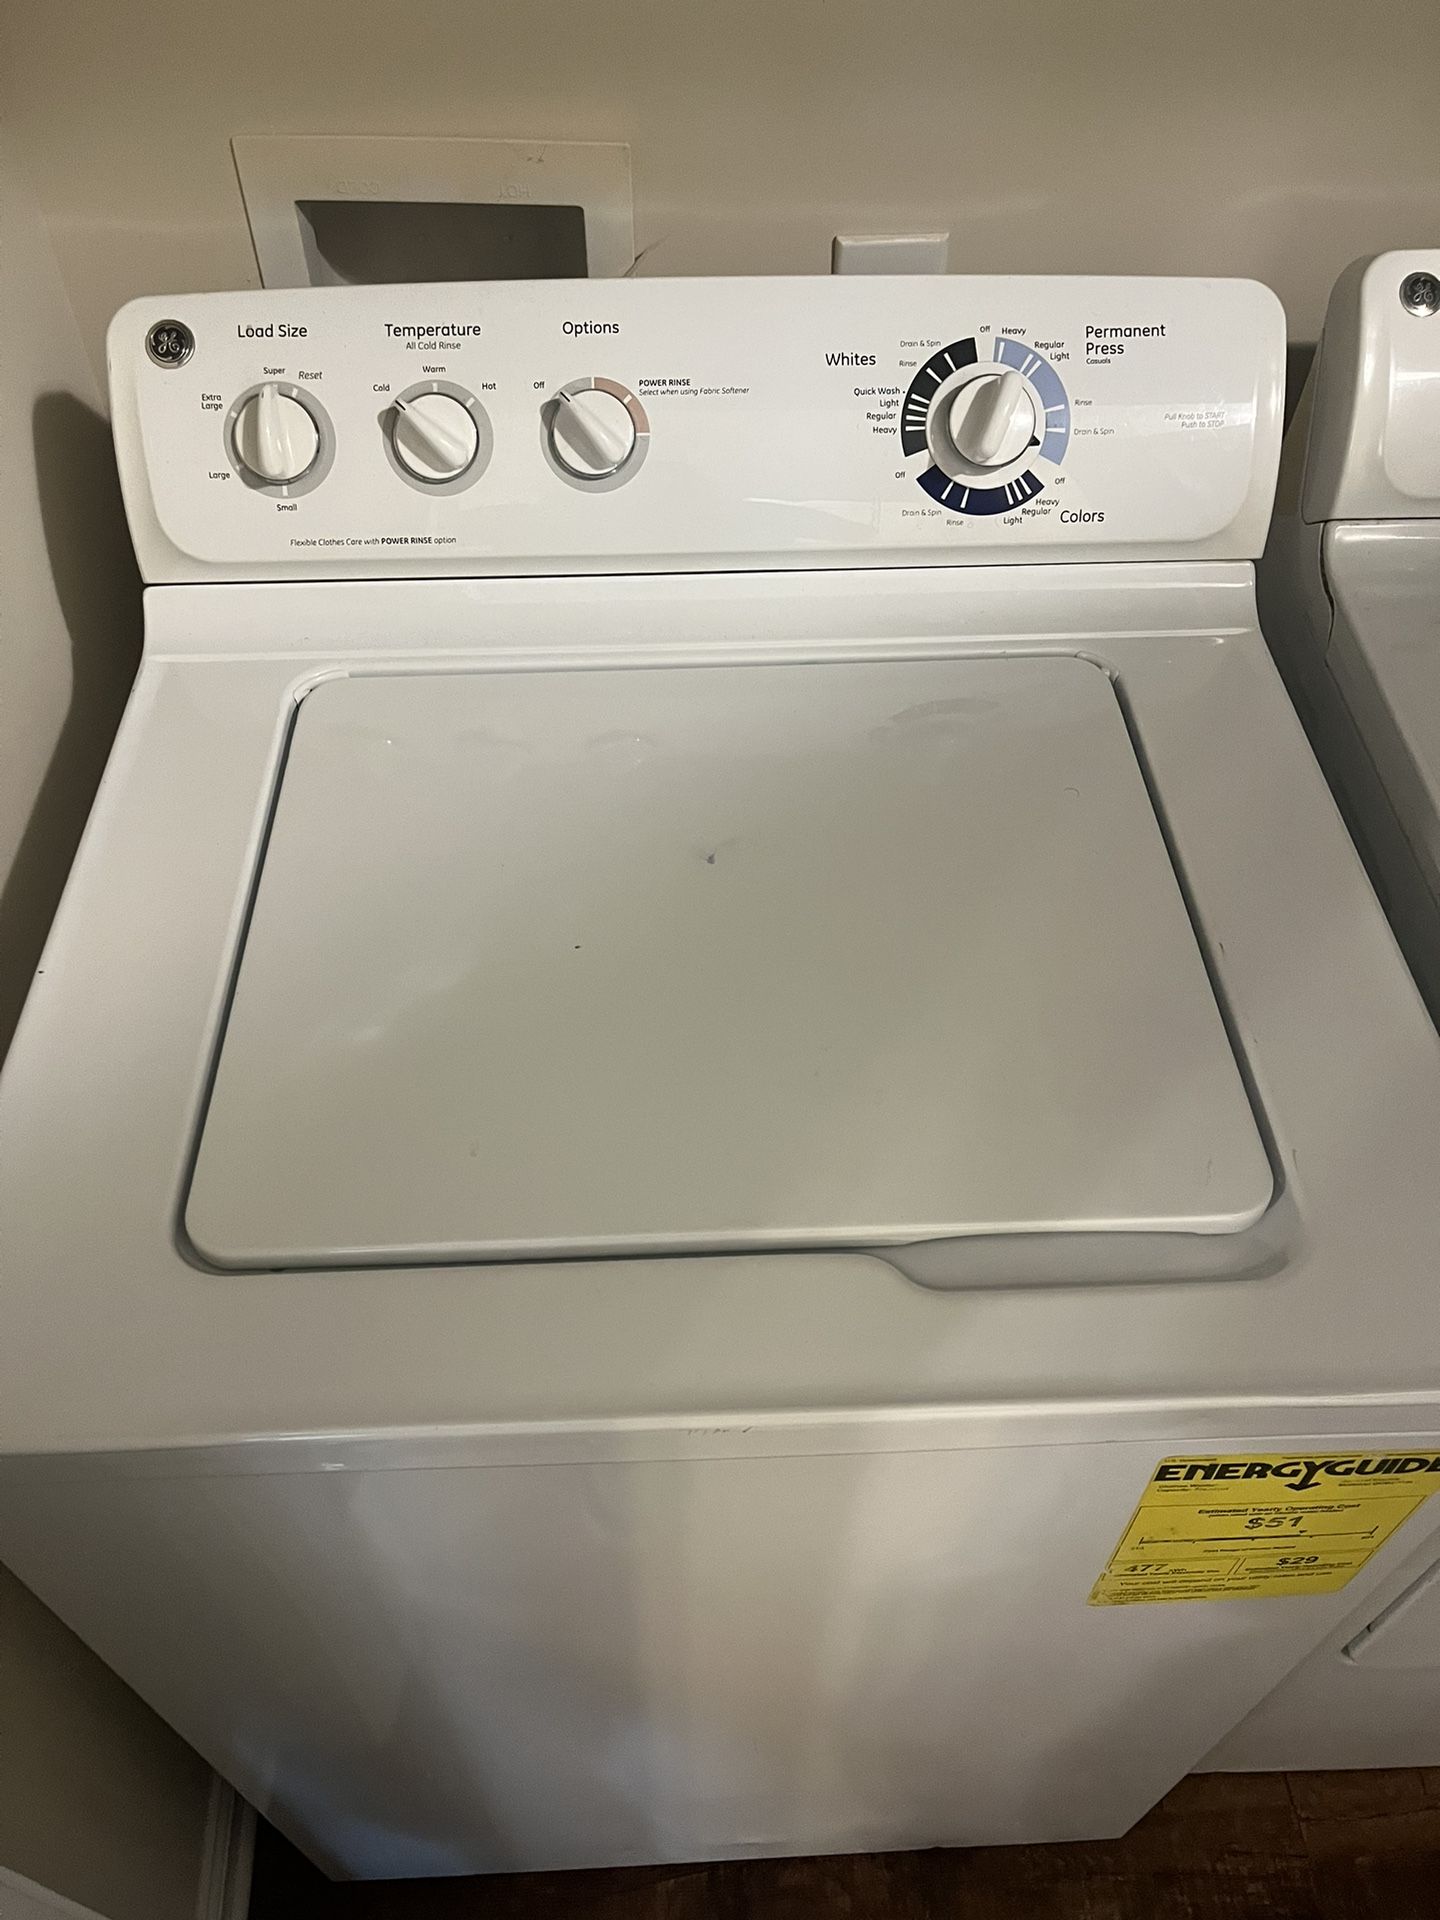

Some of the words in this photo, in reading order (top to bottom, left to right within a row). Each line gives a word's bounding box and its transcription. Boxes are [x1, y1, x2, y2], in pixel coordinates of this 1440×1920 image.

[238, 324, 274, 338] Load
[278, 324, 308, 338] Size
[385, 323, 481, 338] Temperature
[562, 321, 619, 337] Options
[1002, 327, 1026, 336] Heavy
[1086, 325, 1166, 338] Permanent
[406, 341, 416, 349] All
[418, 341, 436, 349] Cold
[439, 341, 461, 349] Rinse
[1034, 341, 1064, 349] Regular
[1086, 342, 1124, 355] Press
[826, 353, 876, 366] Whites
[1050, 352, 1070, 360] Light
[263, 367, 285, 376] Super
[422, 365, 446, 373] Warm
[298, 371, 322, 380] Reset
[482, 382, 496, 390] Hot
[533, 381, 544, 389] Off
[669, 378, 691, 386] RINSE
[373, 384, 390, 392] Cold
[639, 388, 659, 396] Select
[661, 388, 678, 396] when
[680, 388, 698, 396] using
[700, 387, 719, 395] Fabric
[722, 386, 749, 395] Softener
[854, 387, 876, 396] Quick
[878, 387, 900, 395] Wash
[202, 402, 223, 411] Large
[880, 399, 899, 408] Light
[867, 412, 896, 421] Regular
[873, 426, 897, 435] Heavy
[209, 471, 230, 479] Large
[895, 471, 906, 479] Off
[277, 503, 298, 511] Small
[1036, 498, 1059, 507] Heavy
[928, 509, 942, 517] Spin
[1022, 507, 1051, 516] Regular
[1060, 509, 1105, 523] Colors
[1003, 516, 1022, 525] Light
[290, 538, 316, 547] Flexible
[318, 538, 344, 546] Clothes
[364, 537, 380, 545] with
[381, 537, 409, 545] POWER
[434, 536, 456, 545] option
[1245, 1516, 1303, 1529] $51
[1276, 1556, 1319, 1565] $29
[1125, 1564, 1168, 1572] 477
